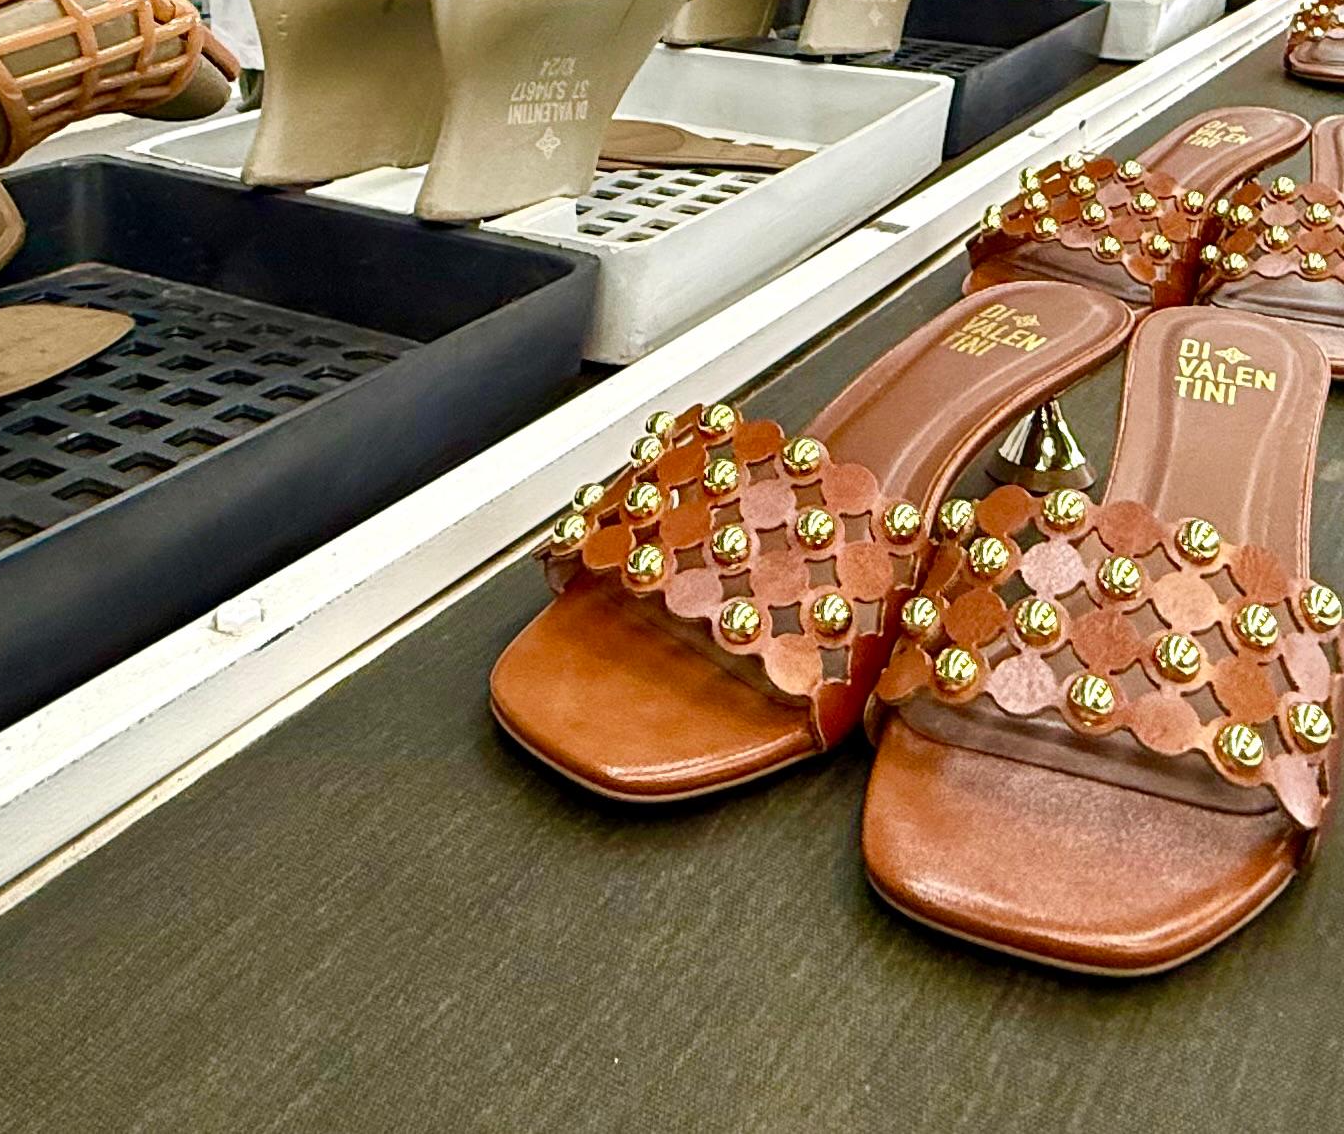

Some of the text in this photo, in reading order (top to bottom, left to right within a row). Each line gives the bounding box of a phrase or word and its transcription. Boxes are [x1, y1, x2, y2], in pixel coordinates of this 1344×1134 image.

[508, 100, 590, 125] DI VALENTINI
[979, 303, 1018, 322] DI
[939, 331, 998, 357] TINI
[961, 316, 1048, 352] VALEN
[1179, 338, 1212, 359] DI
[1178, 356, 1277, 392] VALEN
[1174, 375, 1237, 406] TINI
